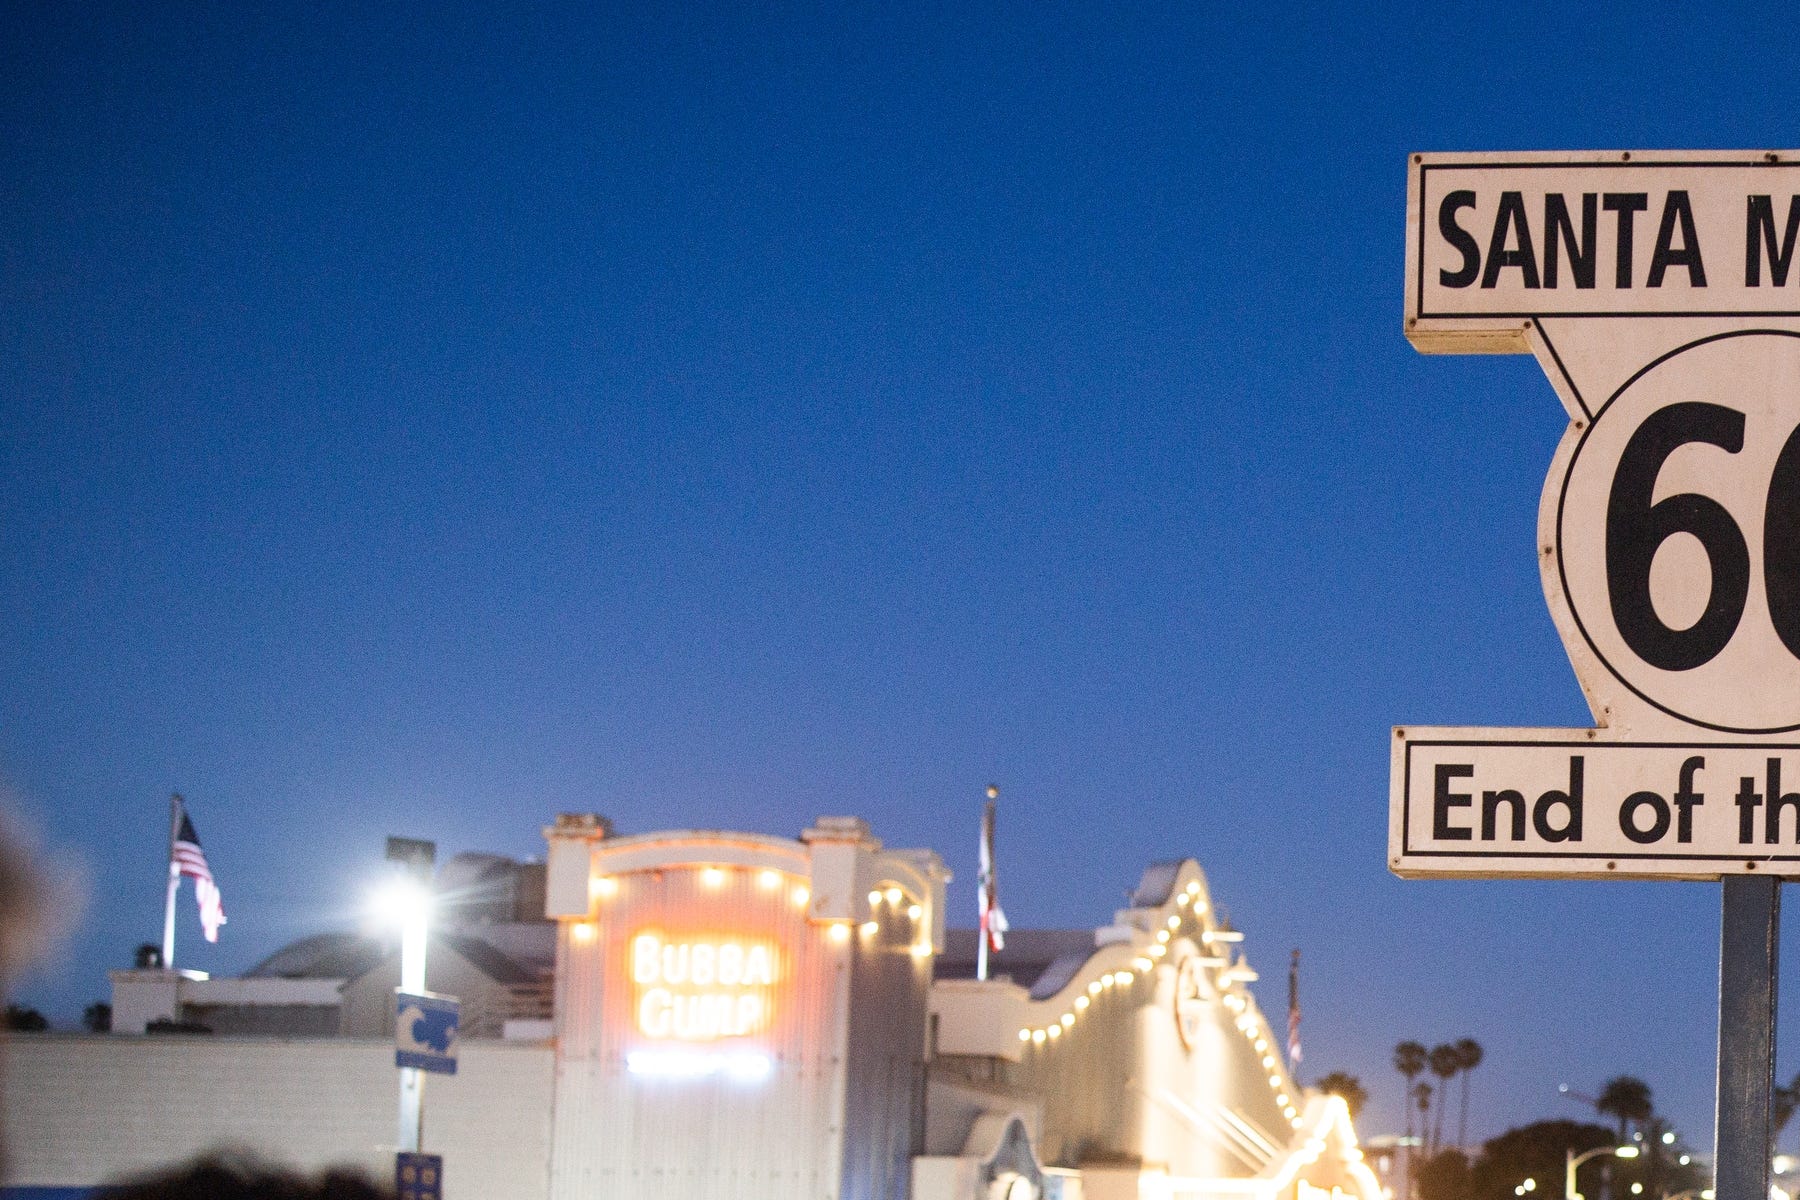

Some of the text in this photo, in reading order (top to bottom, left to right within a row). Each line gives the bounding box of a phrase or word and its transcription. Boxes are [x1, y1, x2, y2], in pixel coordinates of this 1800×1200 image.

[1436, 189, 1710, 291] SANTA
[1432, 756, 1586, 845] End
[1618, 756, 1706, 846] of
[634, 935, 772, 986] BUBBA
